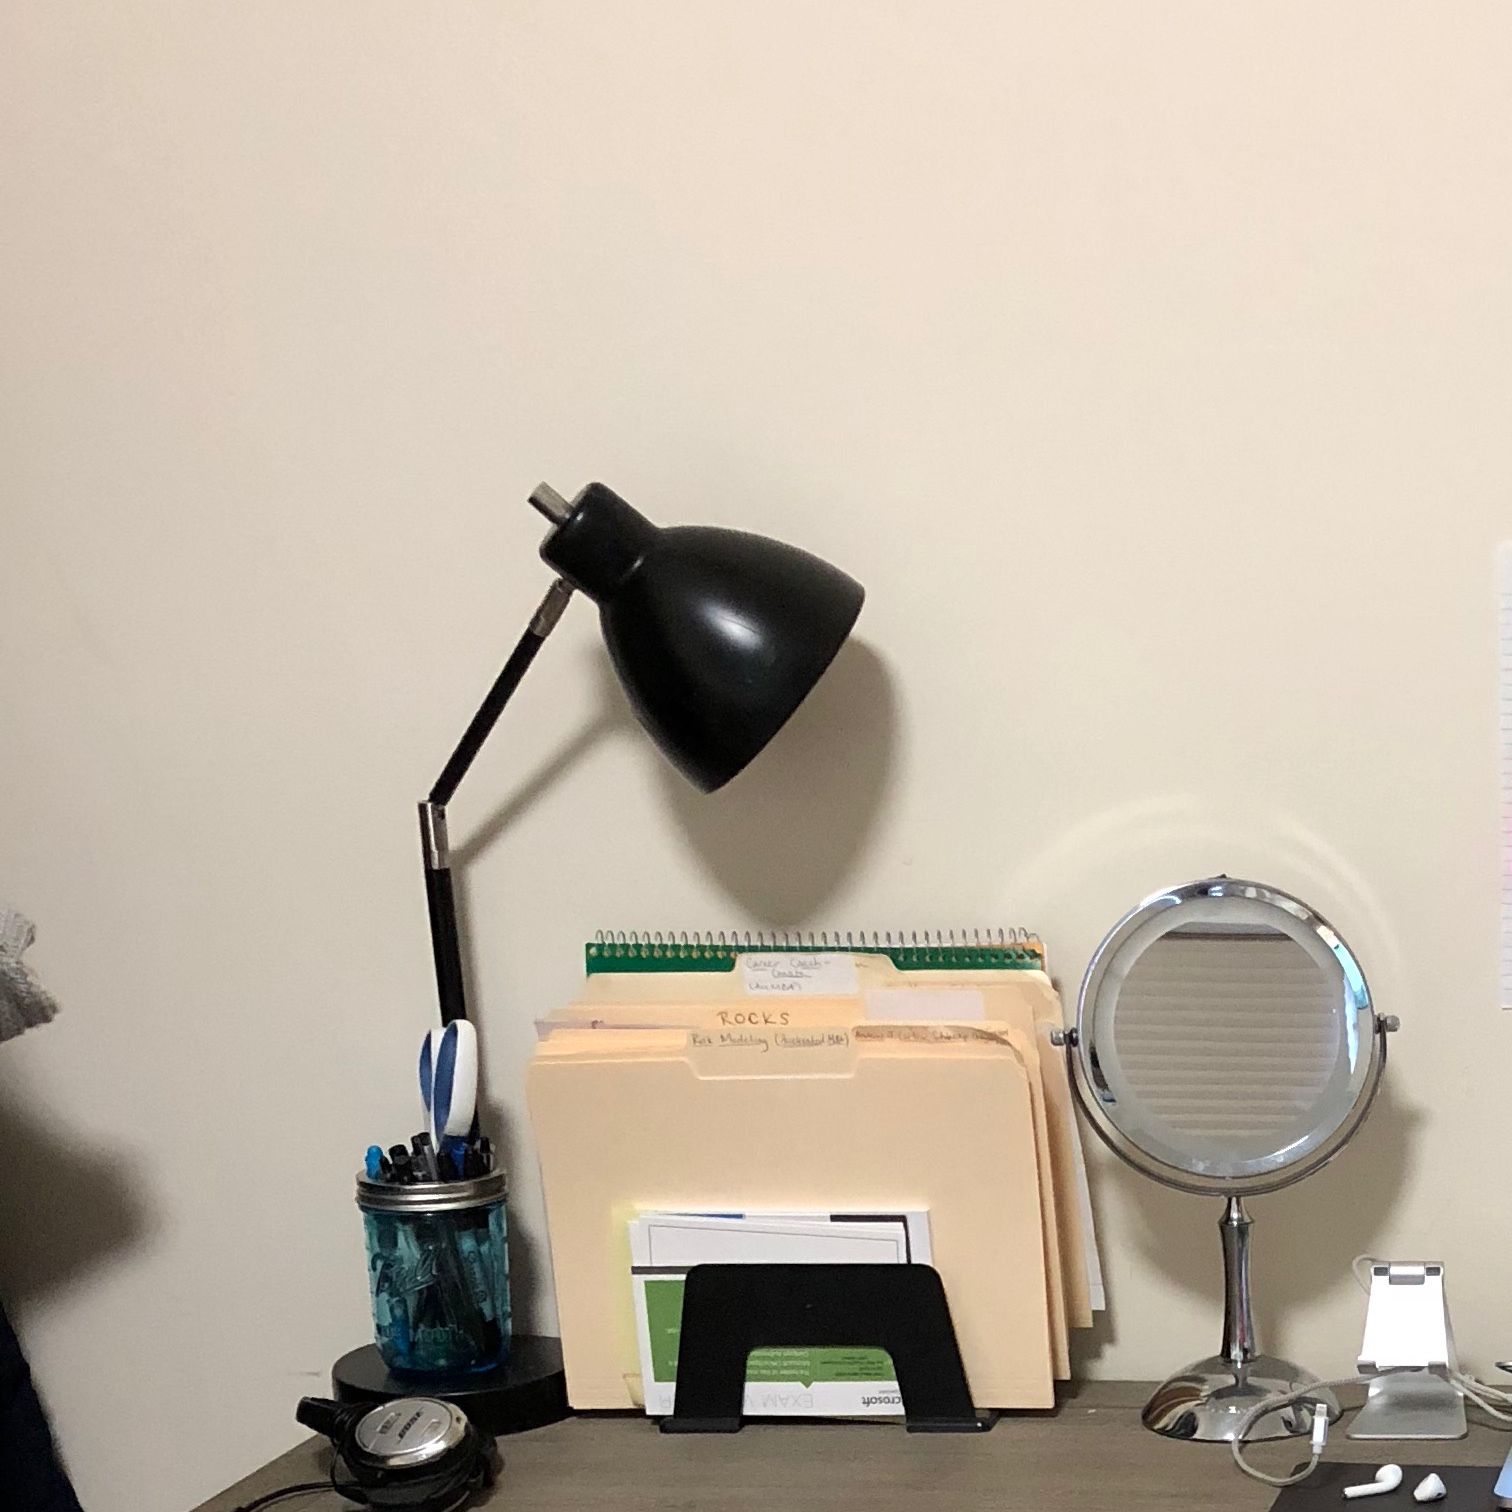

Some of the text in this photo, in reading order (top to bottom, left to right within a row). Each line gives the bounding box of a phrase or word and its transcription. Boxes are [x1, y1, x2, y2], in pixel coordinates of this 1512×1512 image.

[718, 1012, 790, 1026] ROCKS
[762, 1393, 814, 1409] EXAM
[861, 1395, 901, 1408] crosoft
